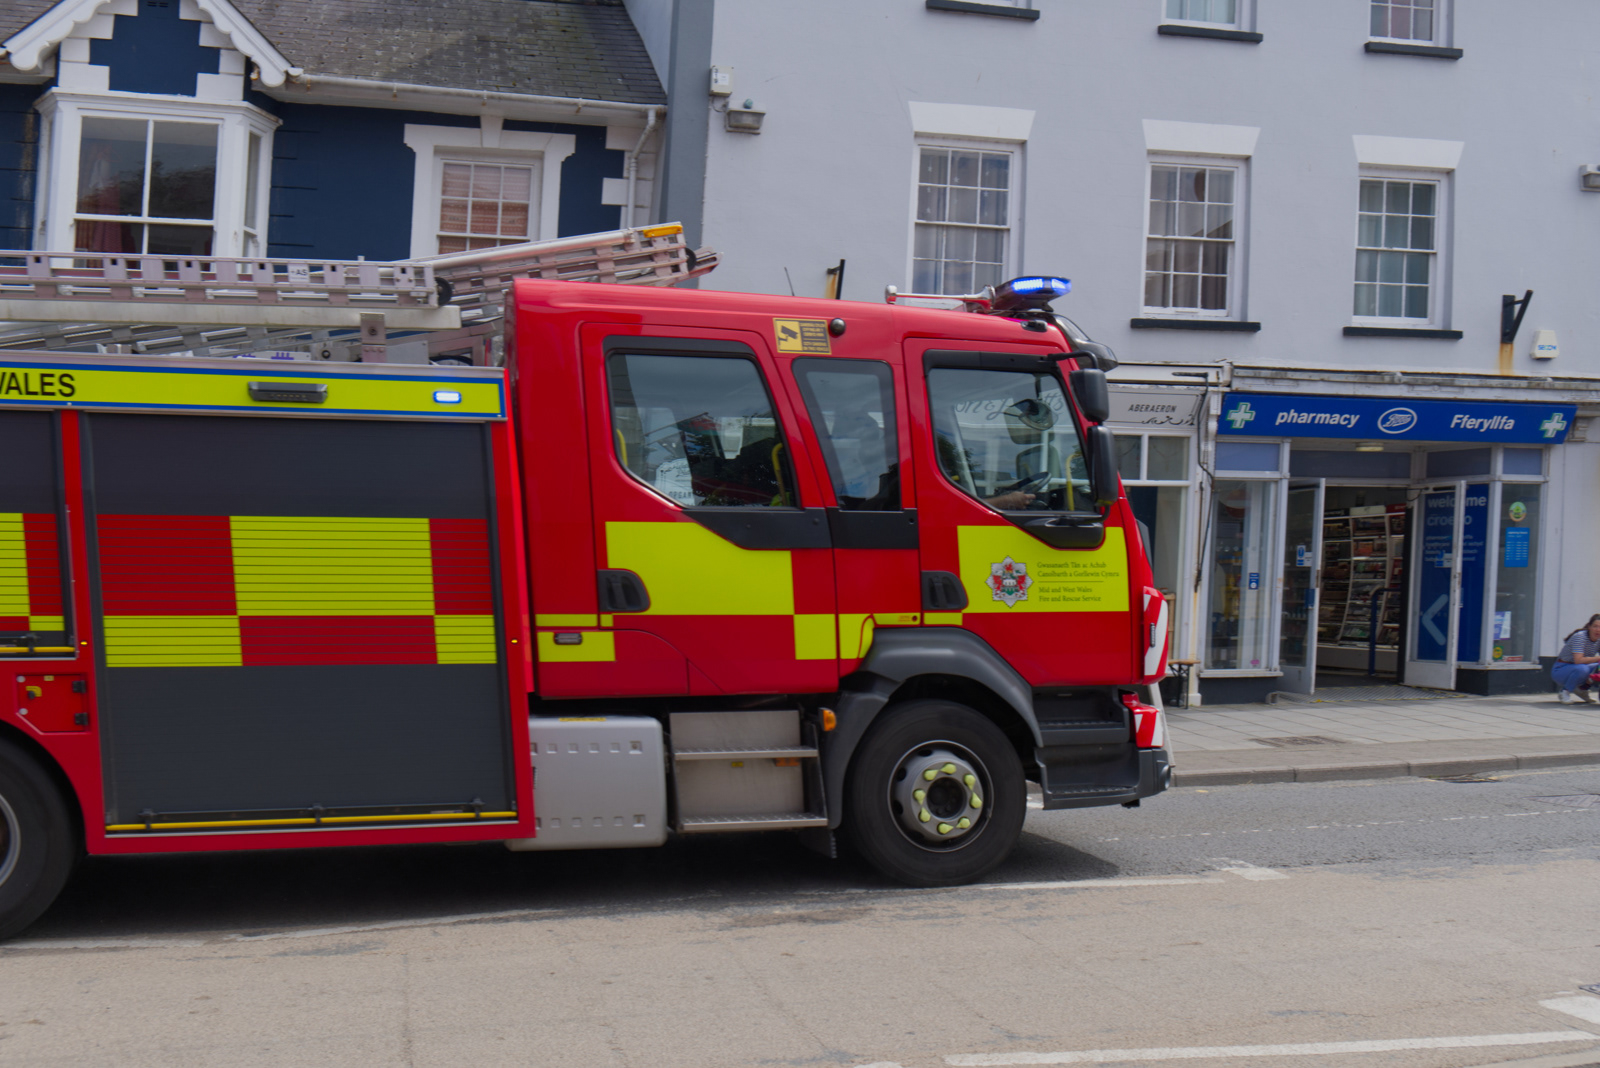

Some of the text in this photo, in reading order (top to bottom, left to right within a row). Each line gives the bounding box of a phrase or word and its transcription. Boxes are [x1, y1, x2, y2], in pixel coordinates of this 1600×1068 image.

[0, 371, 75, 398] ALES
[1128, 403, 1177, 413] ABERAERON
[1275, 409, 1360, 428] pharmacy
[1450, 414, 1515, 432] Fferyllfa
[1428, 495, 1487, 508] welcme
[1427, 515, 1473, 526] croeo
